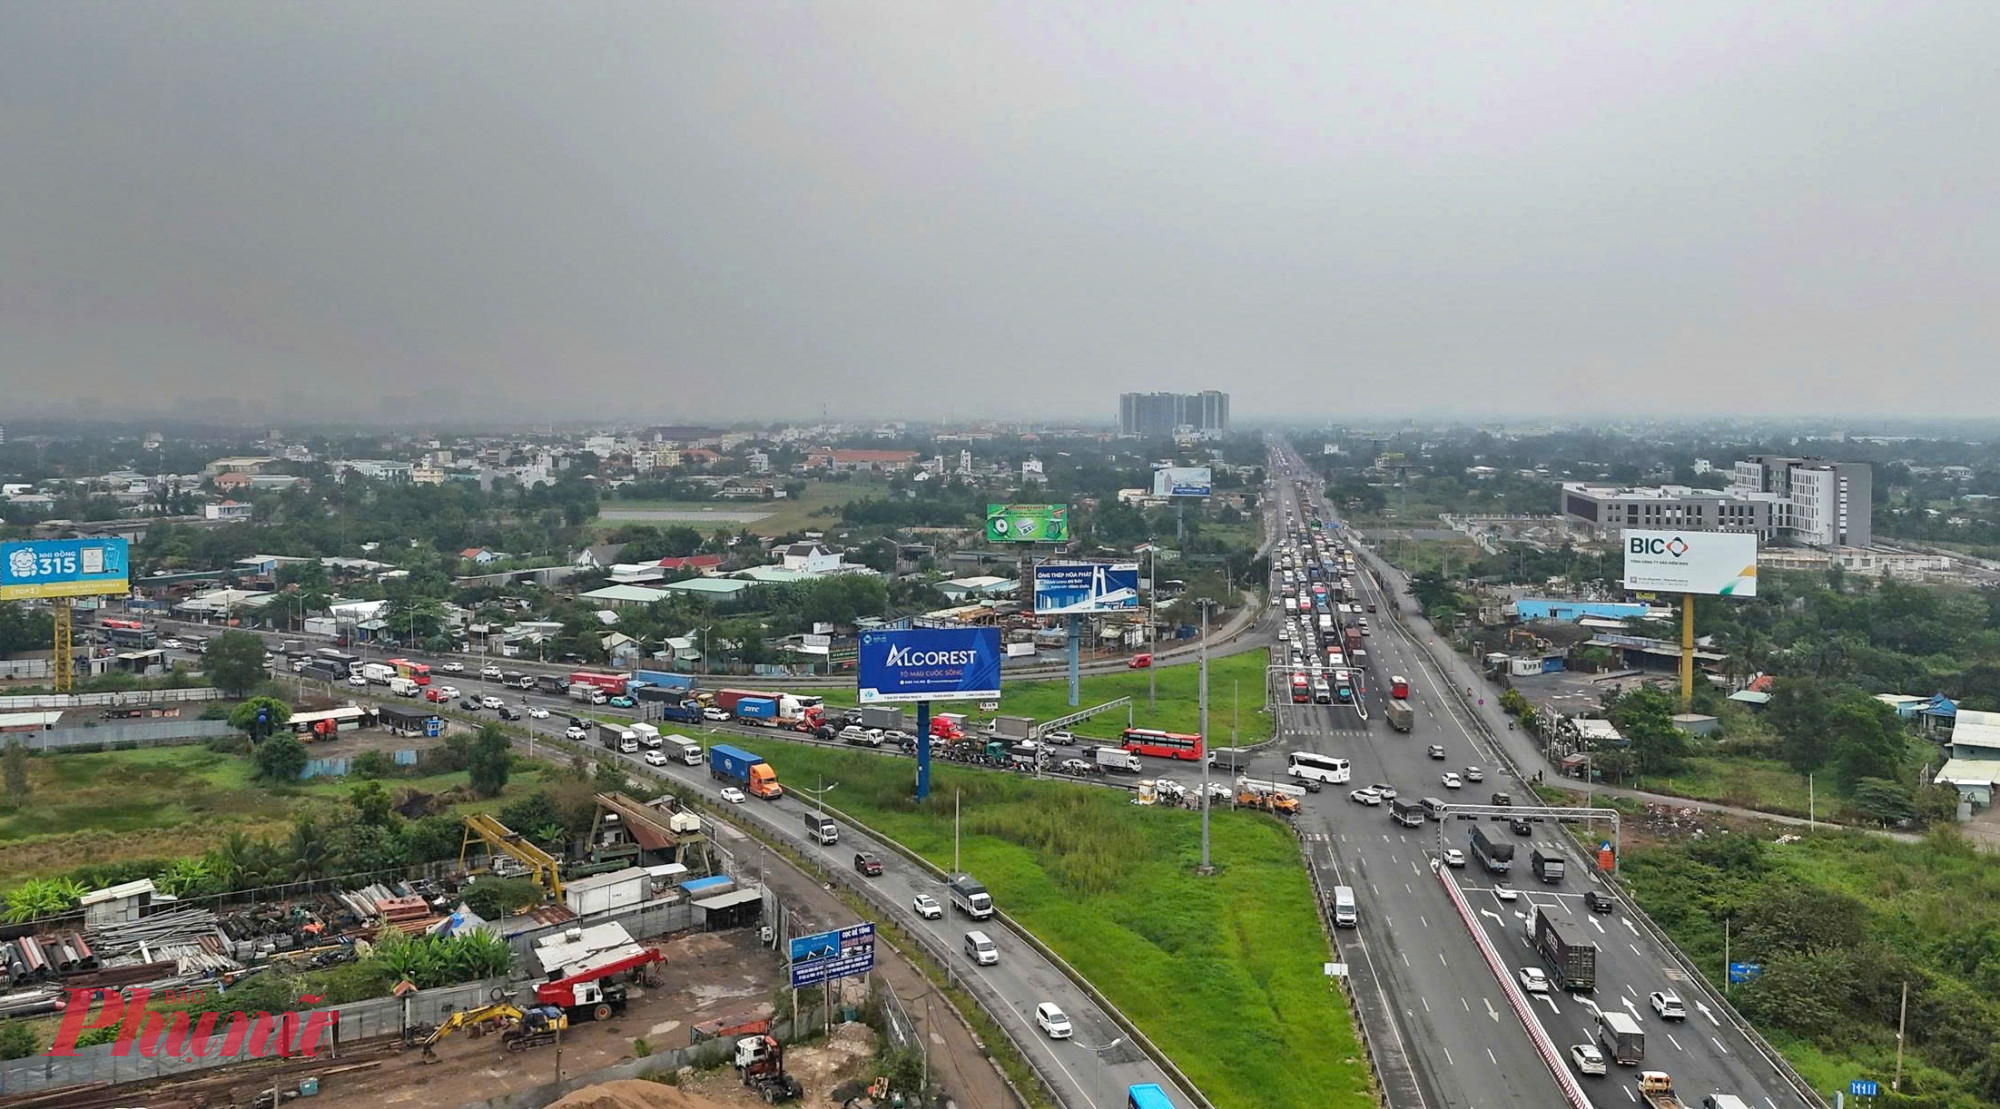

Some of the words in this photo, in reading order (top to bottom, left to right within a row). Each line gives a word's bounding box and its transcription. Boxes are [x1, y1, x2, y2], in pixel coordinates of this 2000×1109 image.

[1630, 537, 1665, 555] BIC
[39, 557, 76, 575] 315
[886, 643, 977, 667] ALCOREST
